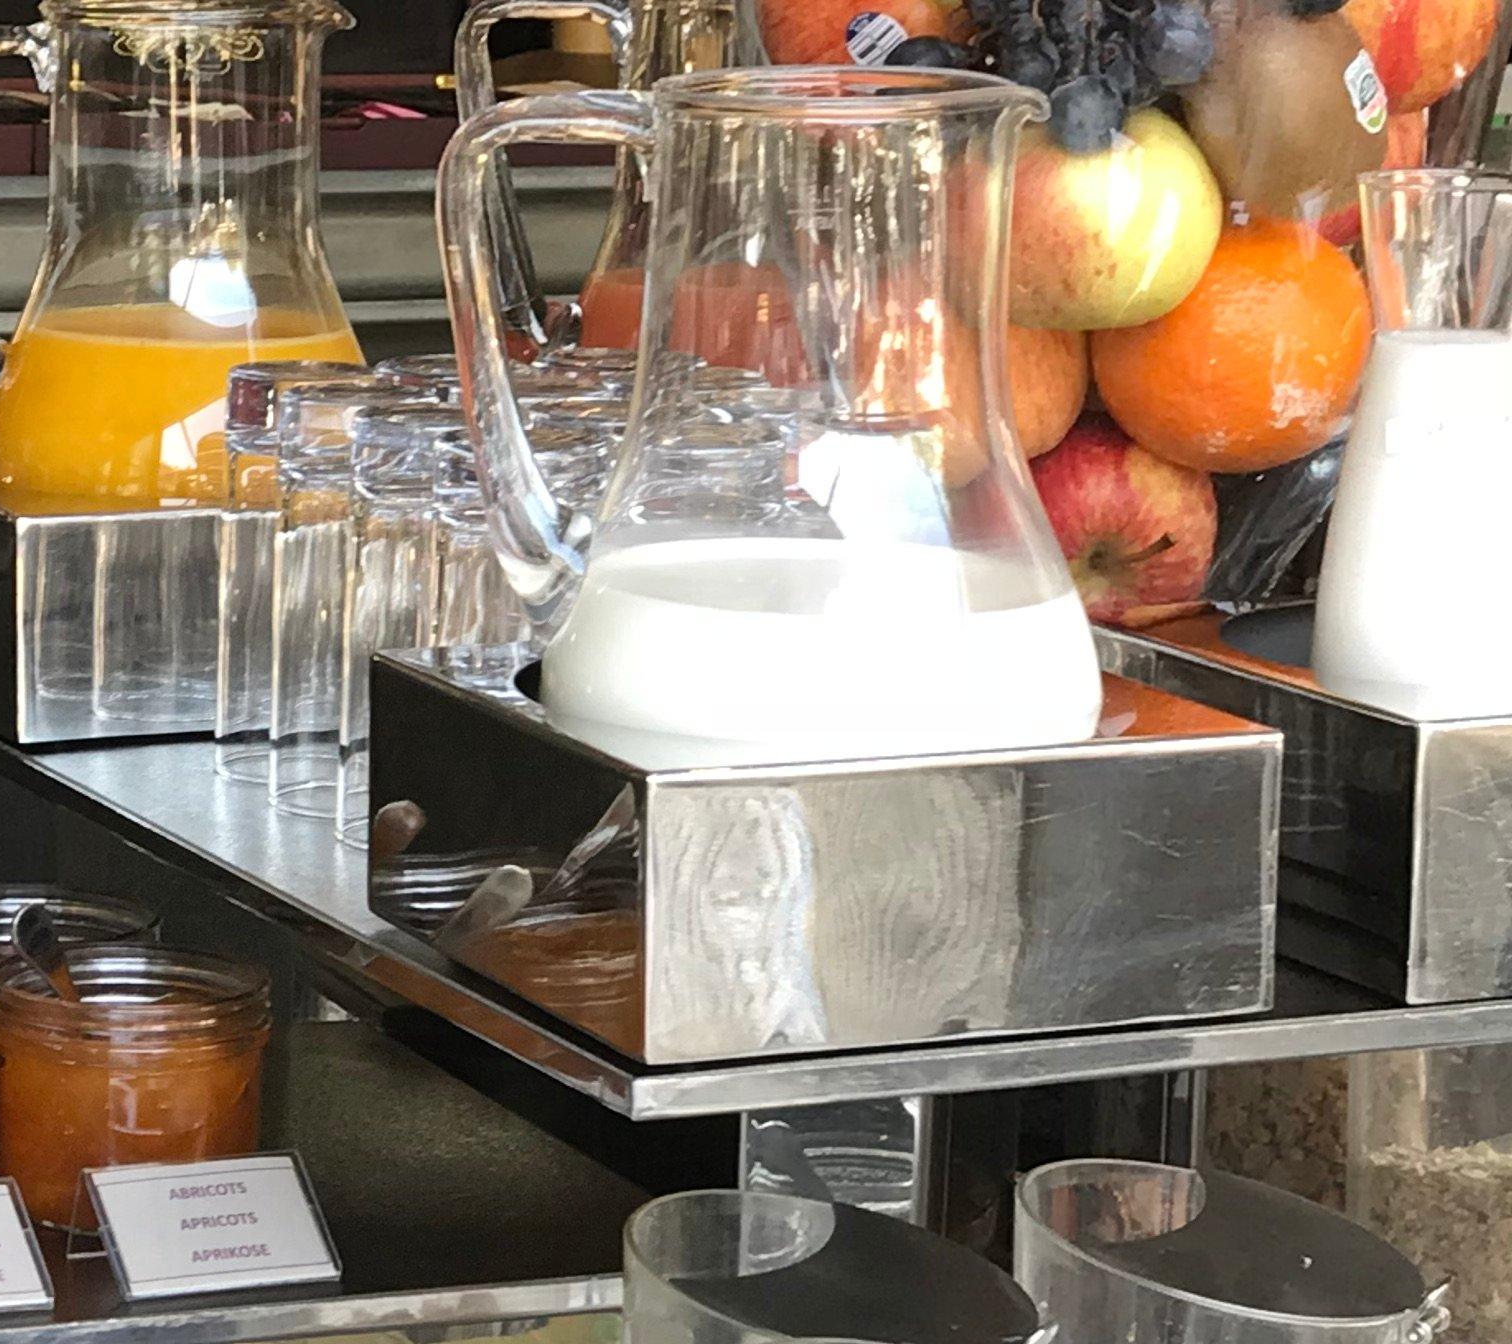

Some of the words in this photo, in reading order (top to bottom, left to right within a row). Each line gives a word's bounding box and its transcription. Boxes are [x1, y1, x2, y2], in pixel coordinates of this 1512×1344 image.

[169, 1181, 247, 1201] ABRICOTS
[180, 1211, 258, 1232] APRICOTS
[191, 1243, 271, 1263] APRIKOSE
